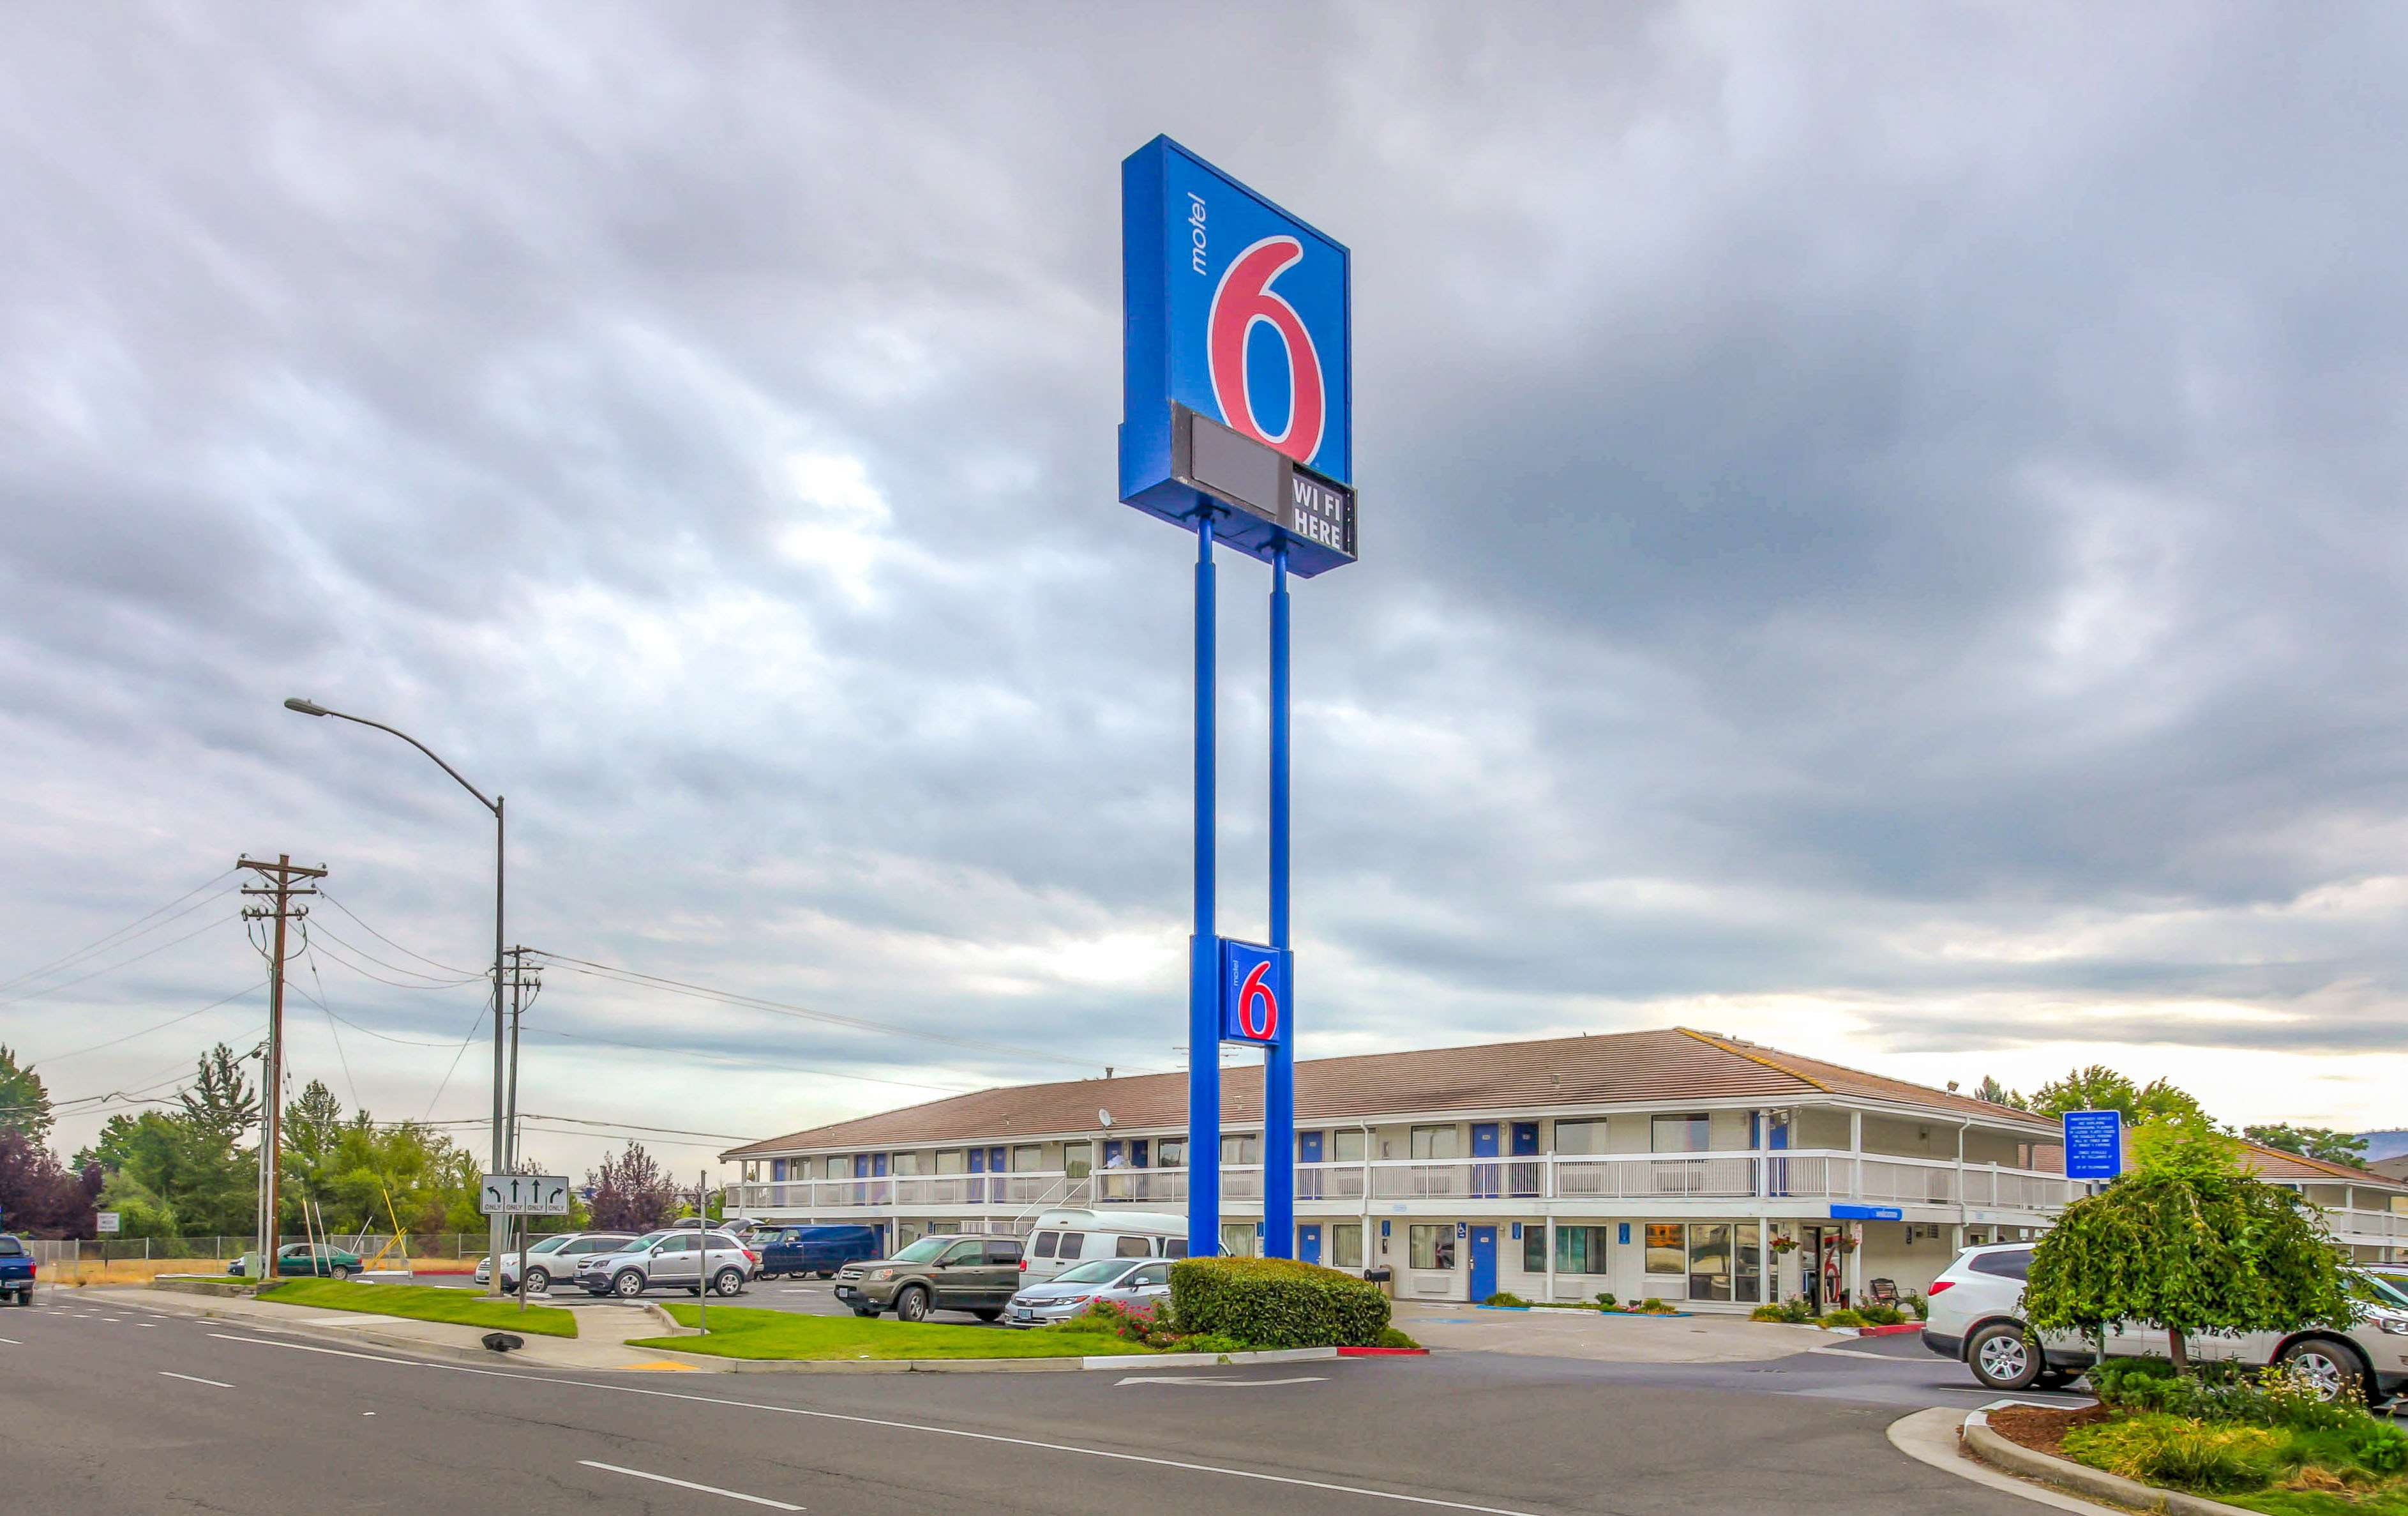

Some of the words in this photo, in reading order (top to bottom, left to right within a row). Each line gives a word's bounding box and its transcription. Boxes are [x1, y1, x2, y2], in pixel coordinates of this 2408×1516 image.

[1187, 192, 1207, 276] motel
[1207, 235, 1326, 465] 6
[1293, 478, 1318, 512] WI
[1325, 494, 1340, 522] FI
[1295, 508, 1341, 550] HERE
[1237, 960, 1278, 1040] 6
[1824, 1246, 1841, 1303] 6
